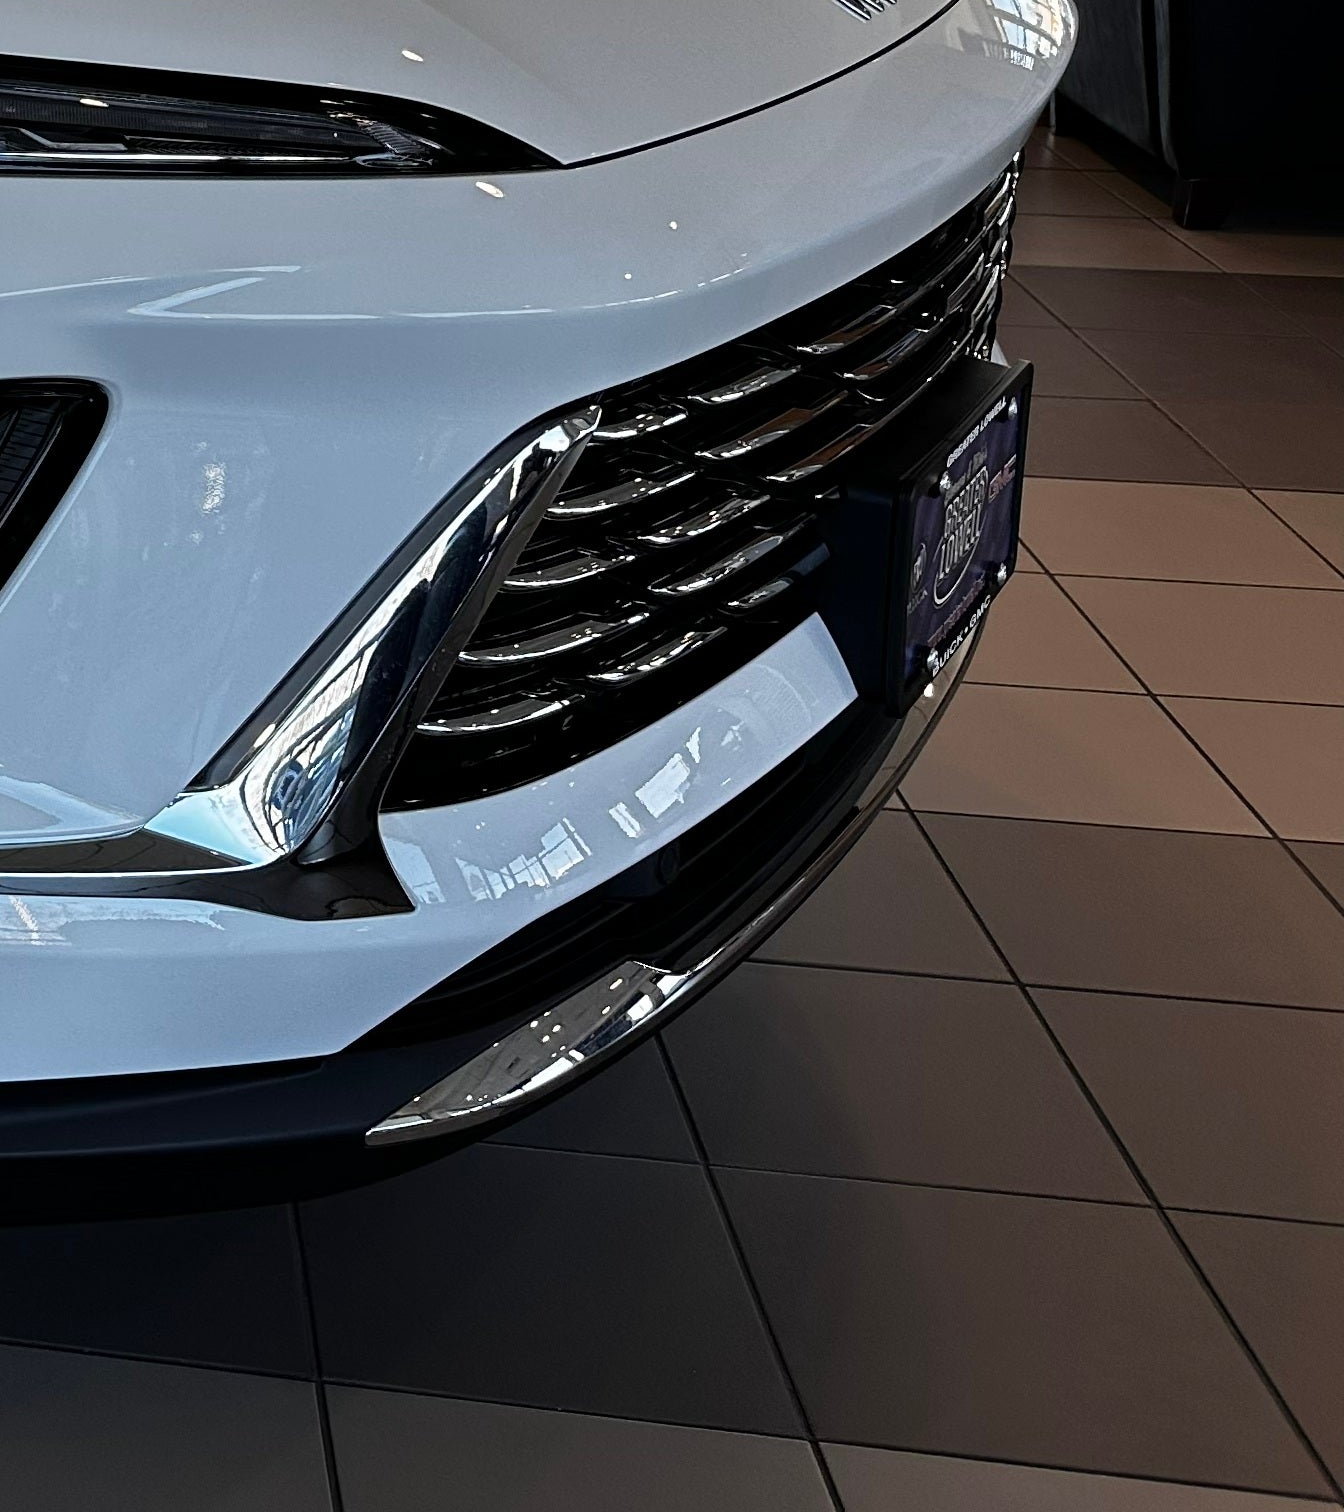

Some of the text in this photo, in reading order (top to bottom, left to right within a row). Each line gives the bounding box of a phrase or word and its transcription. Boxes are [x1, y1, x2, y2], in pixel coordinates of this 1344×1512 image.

[943, 465, 989, 537] GREATER
[937, 502, 985, 581] LOWELL
[931, 630, 965, 678] BUICK
[969, 593, 993, 629] GMC
